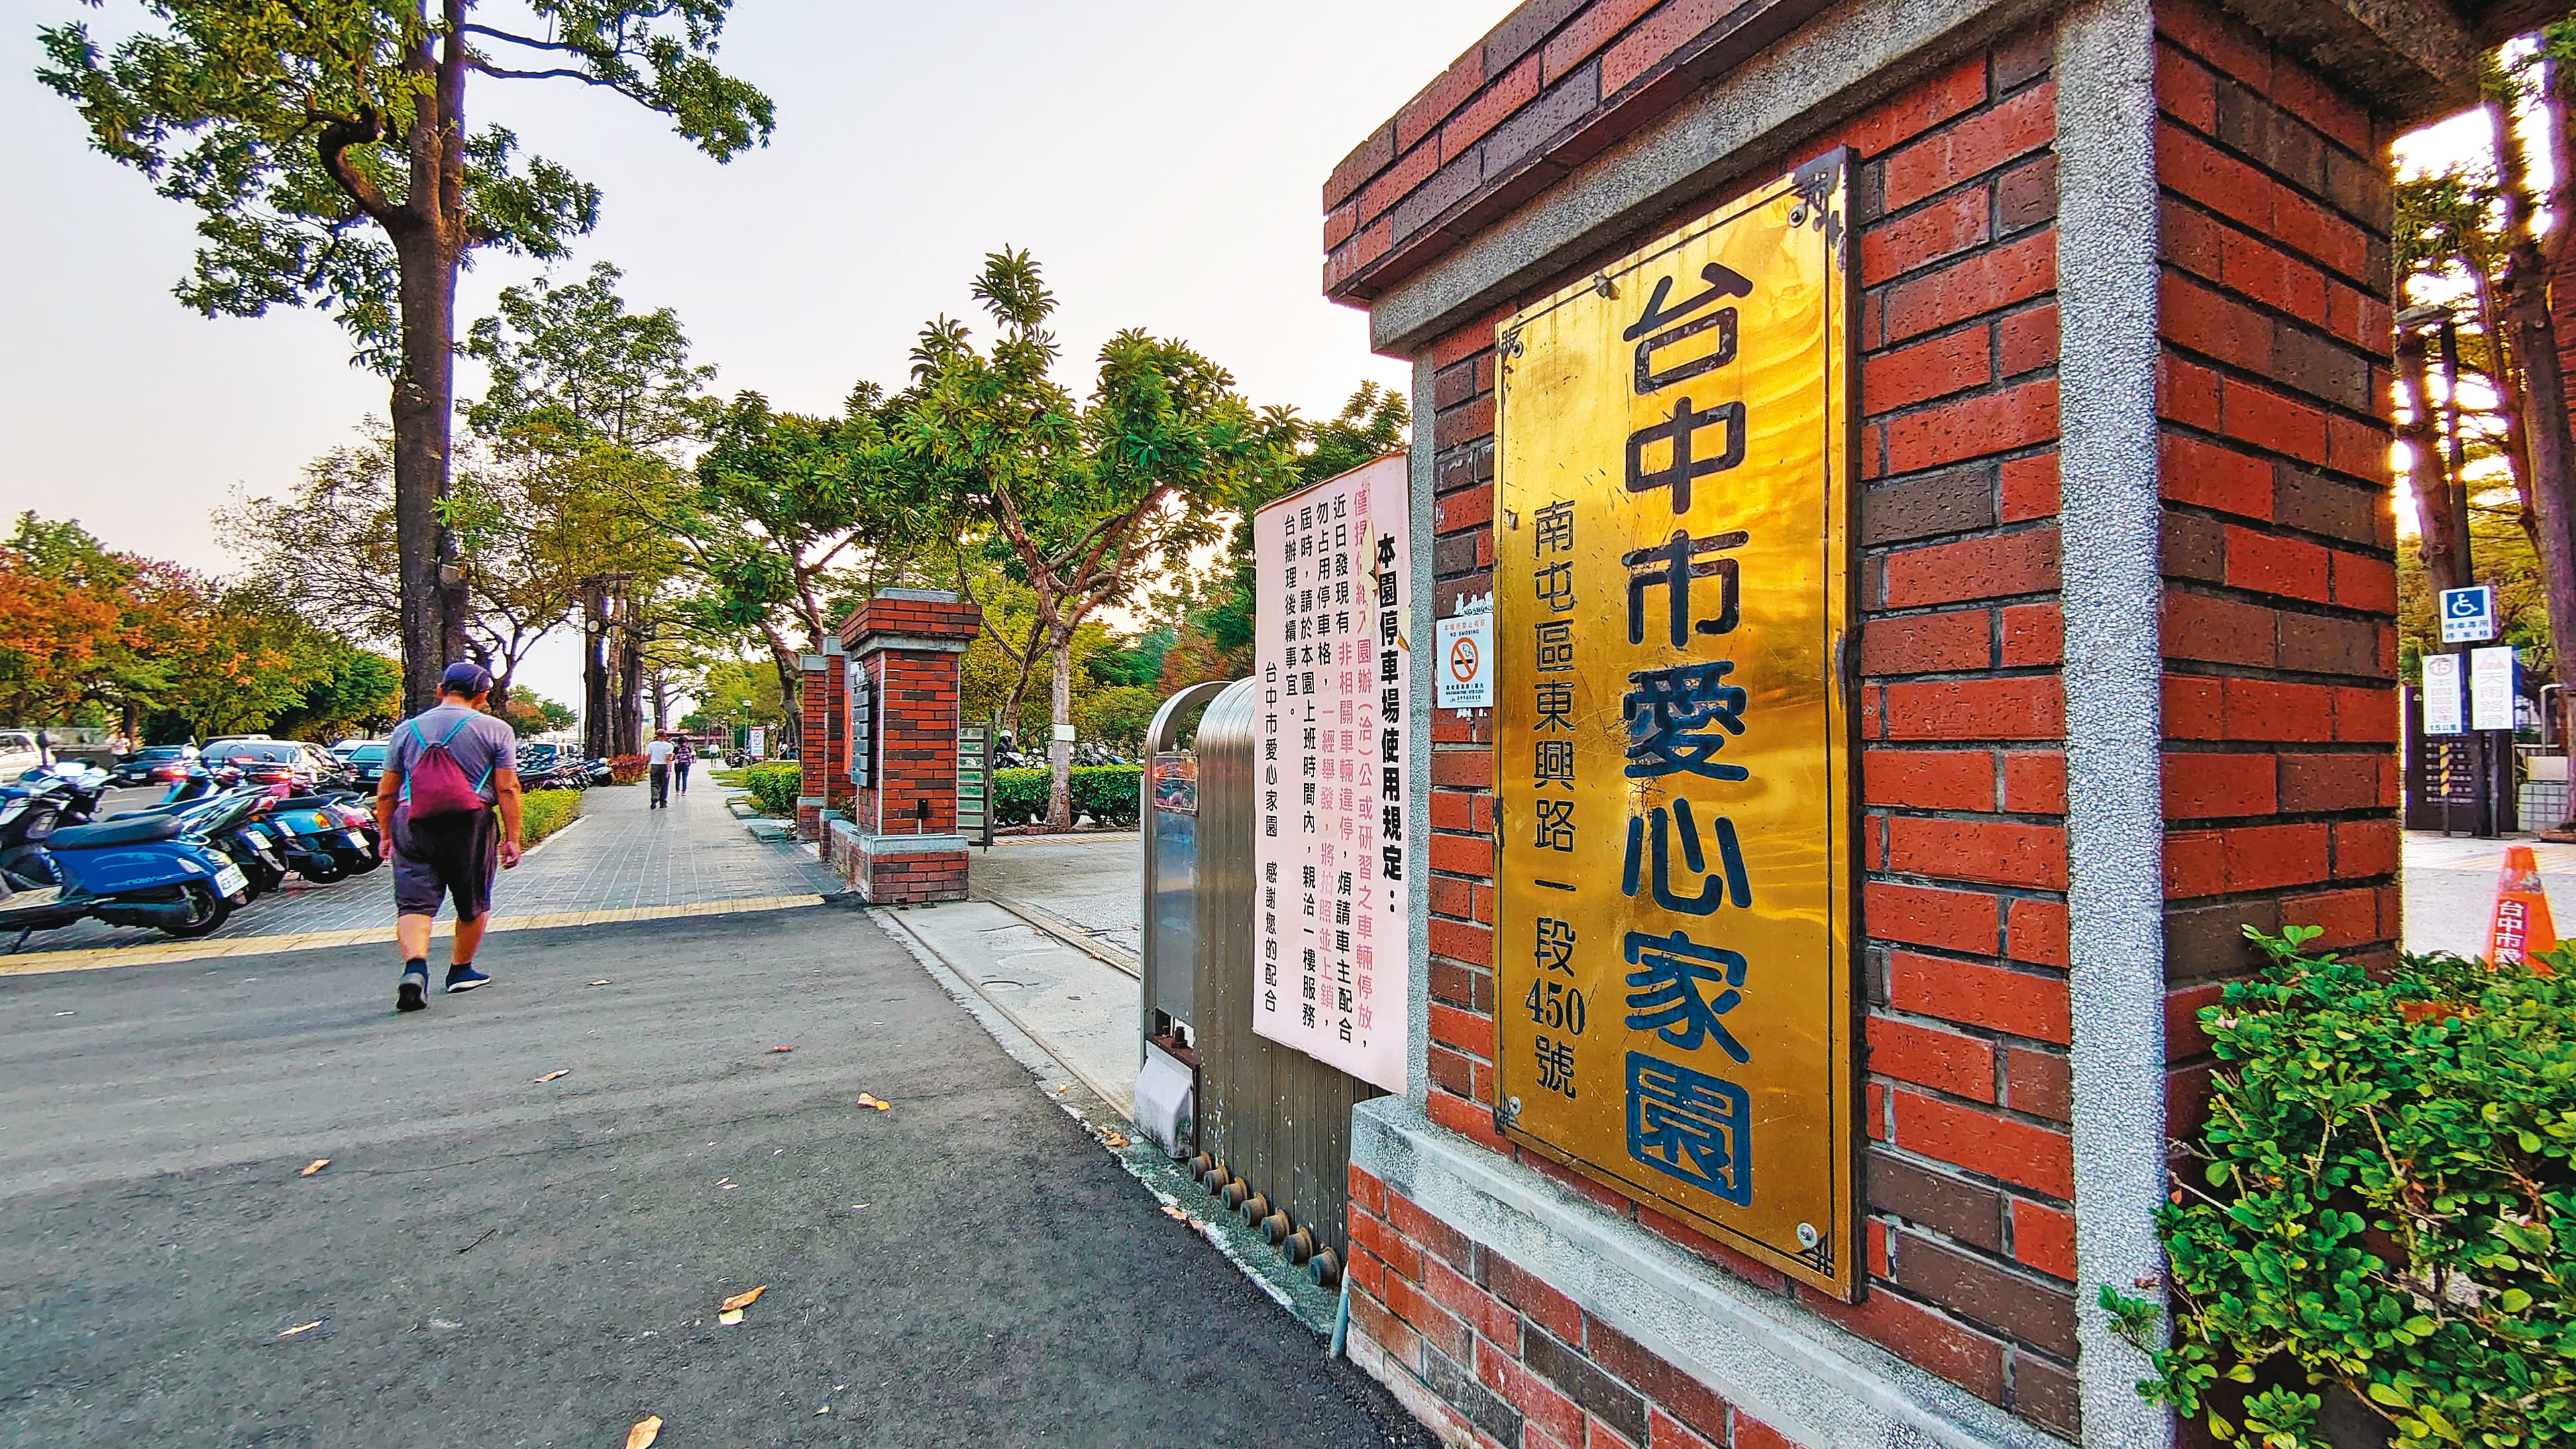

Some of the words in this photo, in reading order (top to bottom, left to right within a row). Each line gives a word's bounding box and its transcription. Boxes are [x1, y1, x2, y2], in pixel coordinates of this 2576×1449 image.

[1283, 513, 1299, 716] 台辦理後續事宜。
[1458, 629, 1479, 637] SMOKING
[1265, 661, 1278, 838] 台中市愛心家園
[1377, 532, 1402, 913] 本園停車場使用規定：
[1525, 500, 1586, 1100] 南屯區東興路一段450號
[1621, 261, 1754, 1208] 台中市愛心家園
[1264, 861, 1278, 1012] 感謝您的配合
